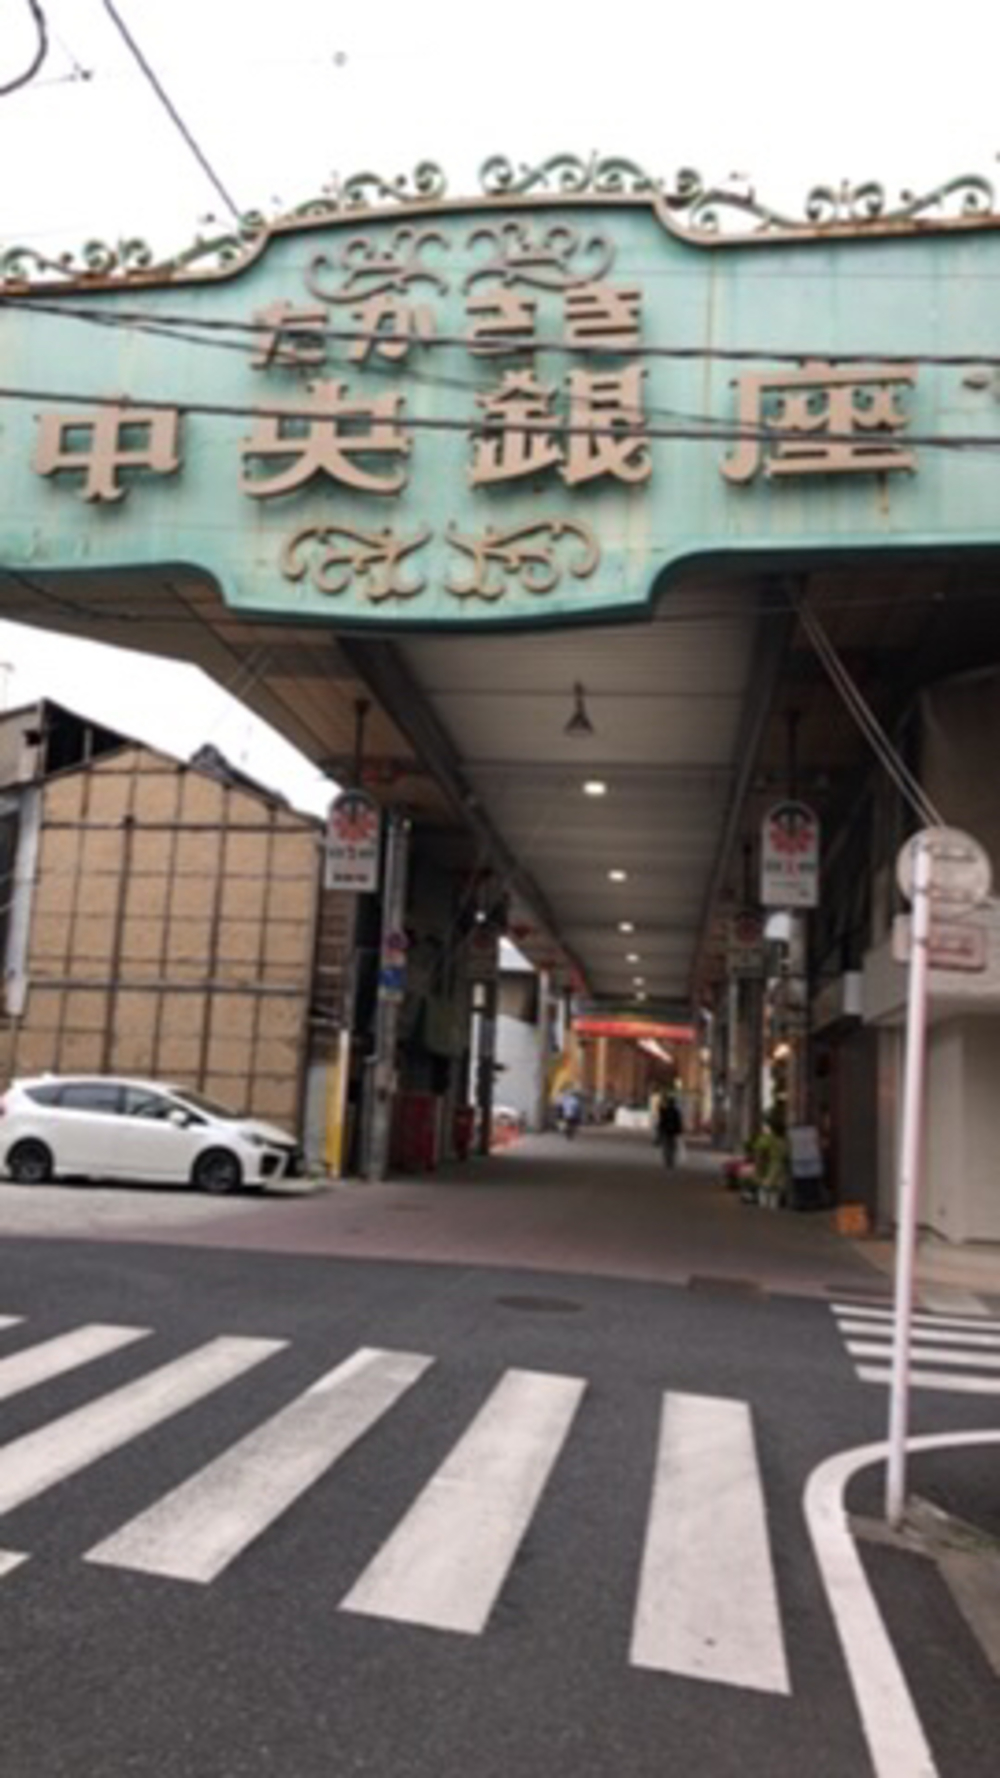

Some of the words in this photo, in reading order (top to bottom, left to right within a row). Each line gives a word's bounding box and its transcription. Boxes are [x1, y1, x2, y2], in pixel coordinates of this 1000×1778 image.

[251, 283, 642, 369] たかさき
[31, 360, 1000, 502] 中央銀座
